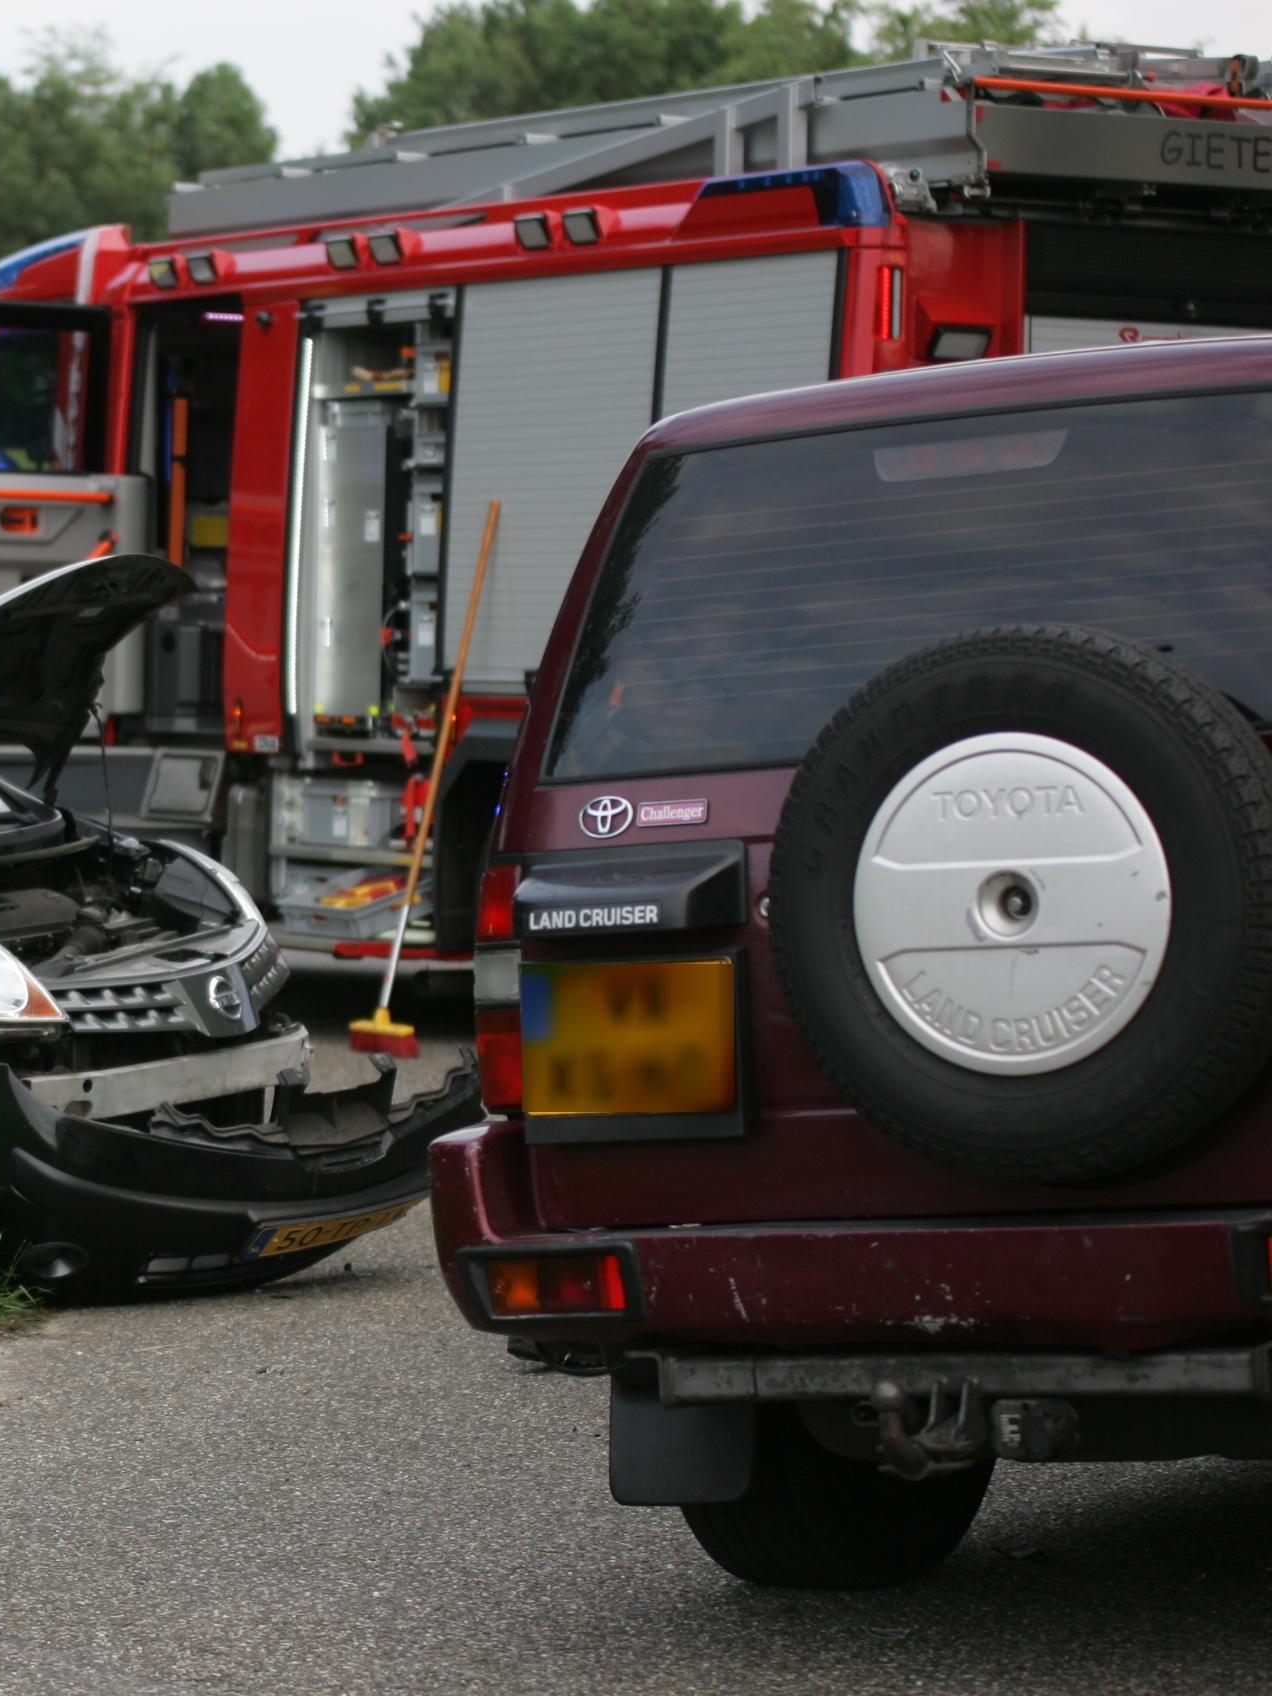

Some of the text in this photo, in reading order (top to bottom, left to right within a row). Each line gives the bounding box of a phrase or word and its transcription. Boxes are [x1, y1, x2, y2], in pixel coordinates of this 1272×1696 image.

[639, 804, 705, 821] Challenger
[931, 784, 1086, 822] TOYOTA
[529, 905, 659, 931] LAND CRUISER
[902, 964, 1126, 1051] LAND CRUISER
